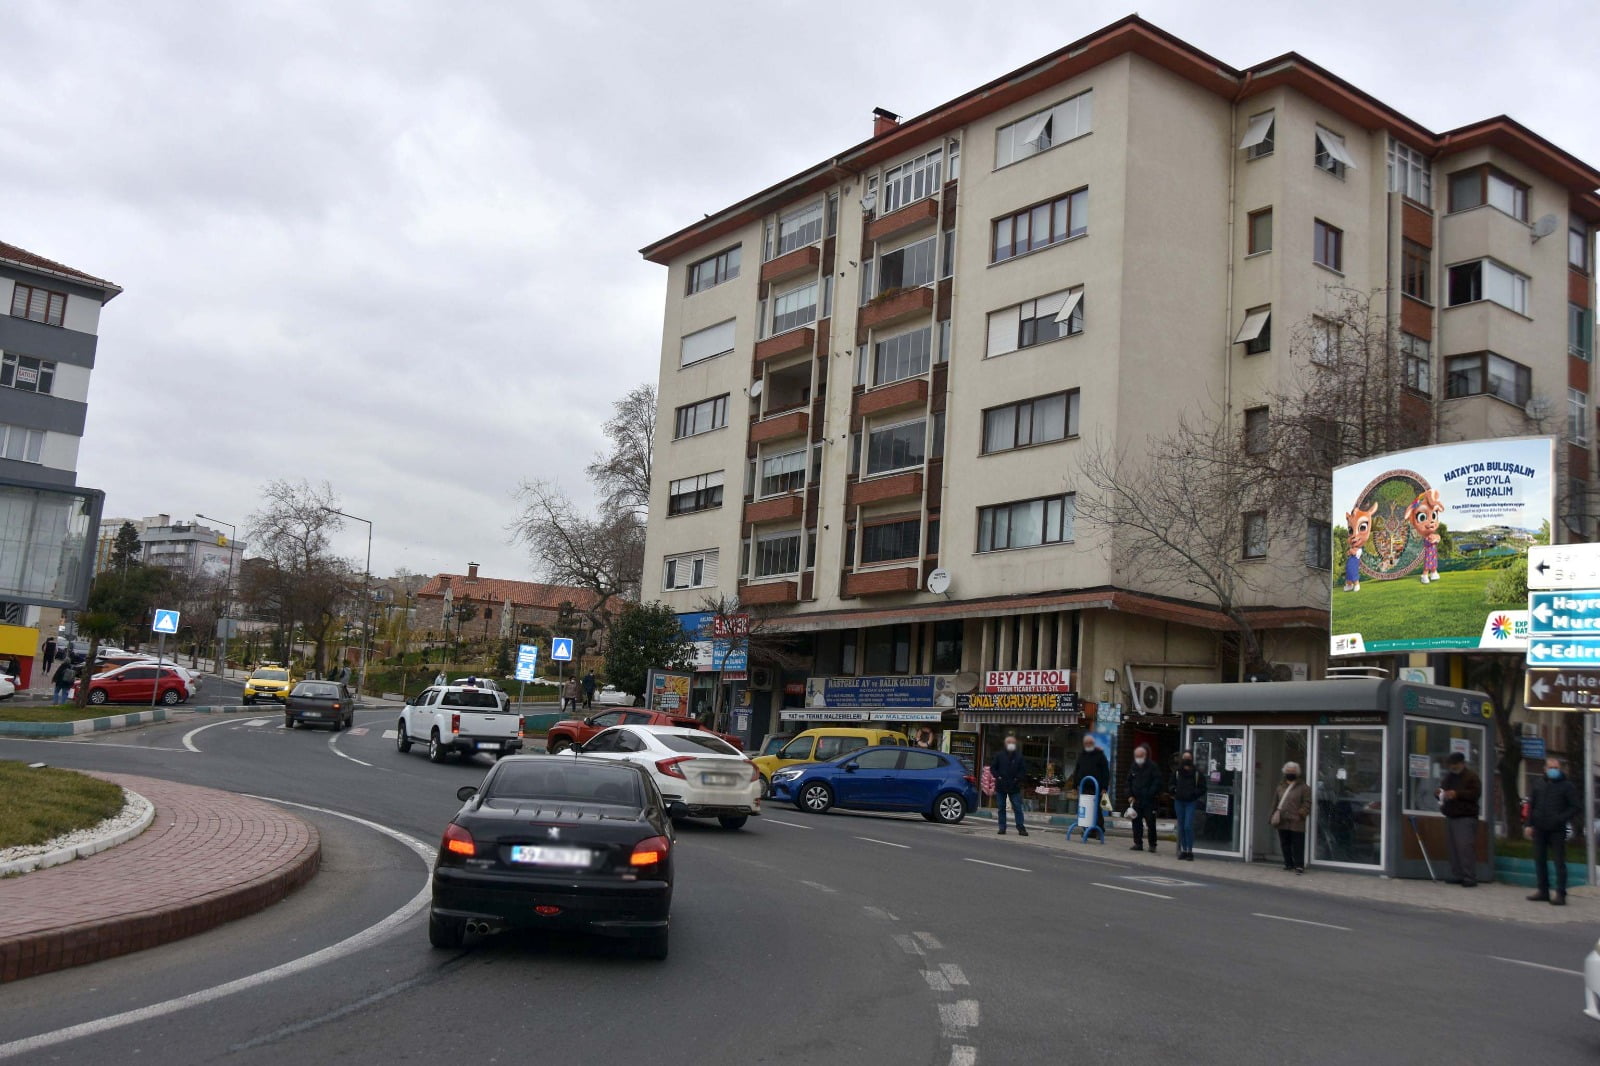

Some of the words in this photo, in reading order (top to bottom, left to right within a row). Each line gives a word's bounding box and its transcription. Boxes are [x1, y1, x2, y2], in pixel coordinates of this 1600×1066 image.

[1444, 462, 1485, 482] HATAY'DA
[1487, 461, 1535, 478] BULUŞALIM
[1467, 475, 1511, 486] EXPO'YLA
[1465, 487, 1513, 498] TANIŞALIM
[989, 671, 1014, 685] BEY
[1017, 670, 1065, 685] PETROL
[1554, 673, 1600, 687] Arke
[970, 693, 996, 708] ÜNAL
[997, 693, 1058, 711] KURUYEMİŞ
